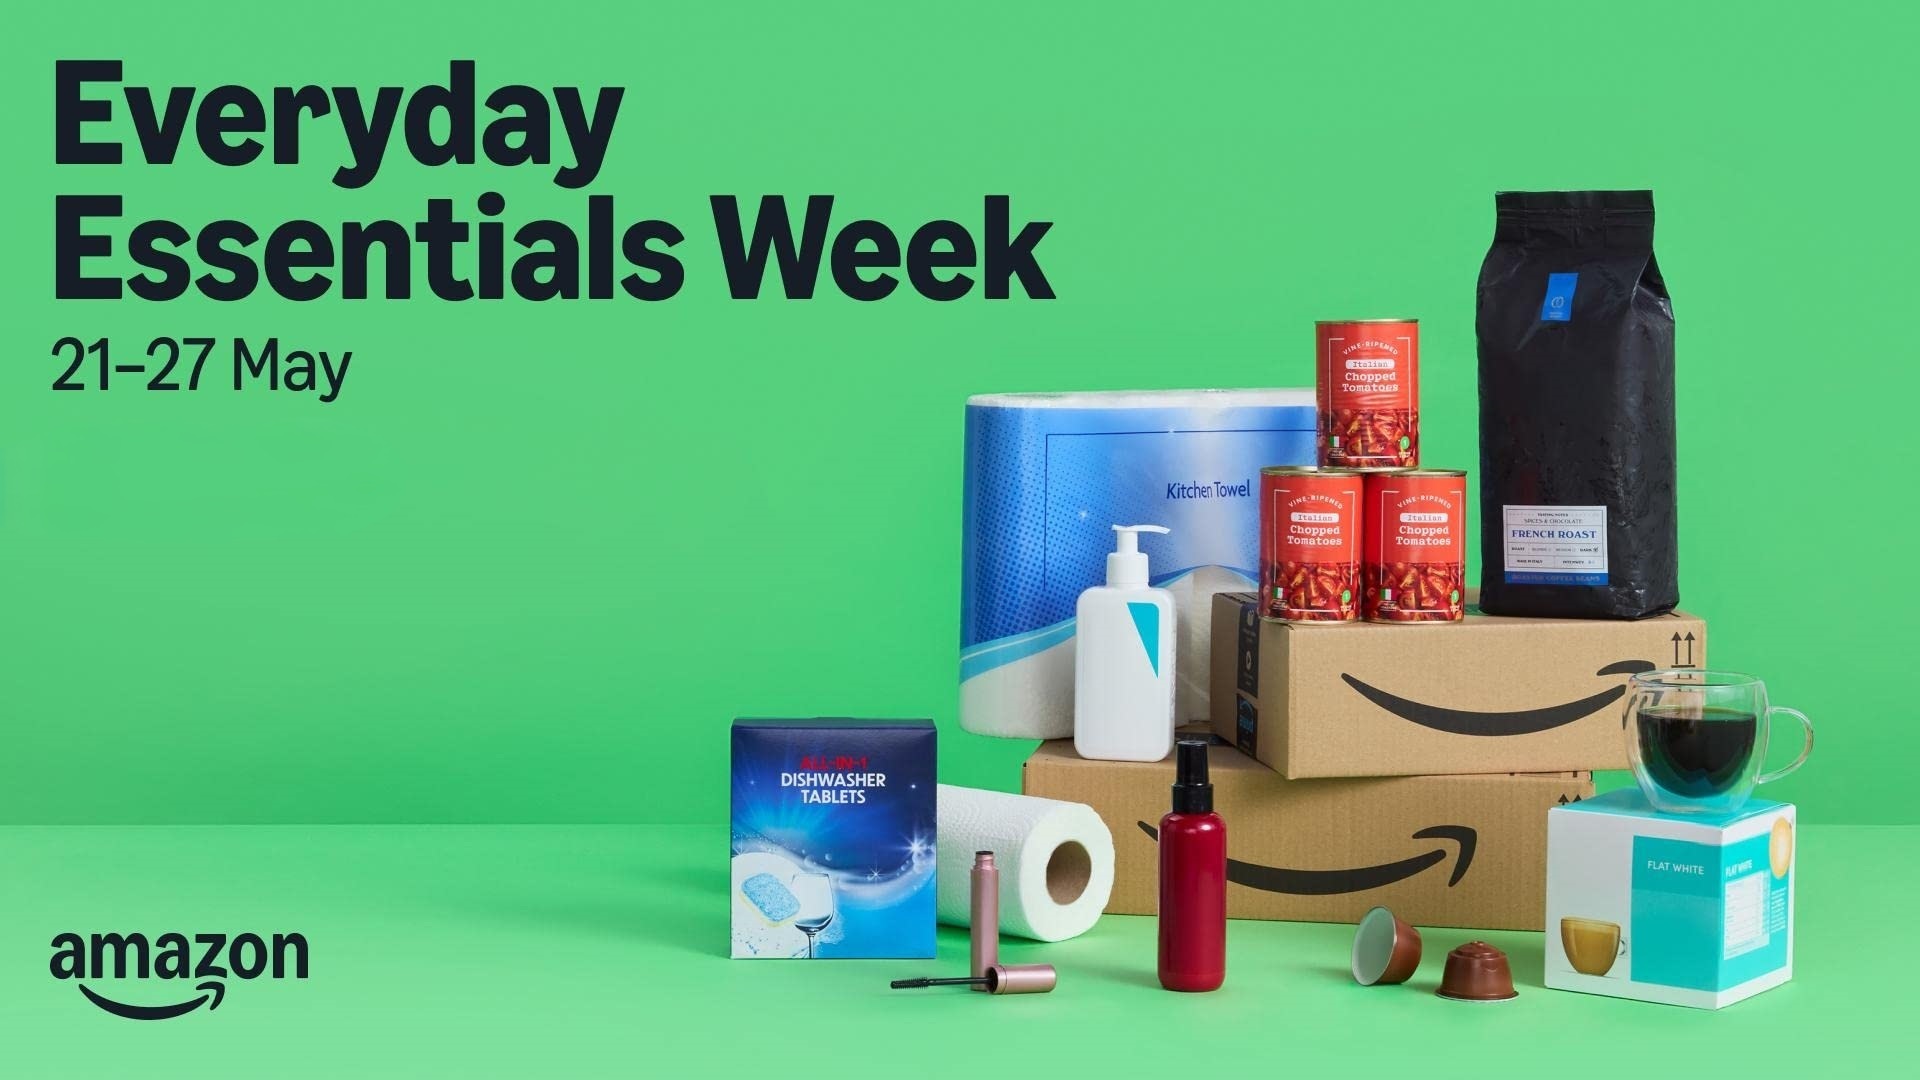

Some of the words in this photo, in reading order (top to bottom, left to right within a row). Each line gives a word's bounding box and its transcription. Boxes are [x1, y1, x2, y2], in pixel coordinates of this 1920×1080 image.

[1345, 371, 1396, 383] Chopped
[1342, 384, 1399, 392] Tomatoes
[1166, 480, 1213, 499] Kitchen
[1214, 479, 1251, 498] Towel
[1290, 525, 1341, 537] Chopped
[1399, 526, 1449, 537] Chopped
[1512, 529, 1555, 538] FRENCH
[1558, 530, 1597, 539] ROAST
[1287, 536, 1343, 546] Tomatoes
[1396, 536, 1451, 546] Tomatoes
[801, 756, 868, 770] ALL-IN-1
[781, 773, 886, 787] DISHWASHER
[801, 790, 866, 804] TABLETS
[1647, 860, 1670, 871] FLAT
[1672, 863, 1704, 875] WHITE
[1725, 864, 1738, 877] FLAT
[1738, 859, 1753, 873] WHITE
